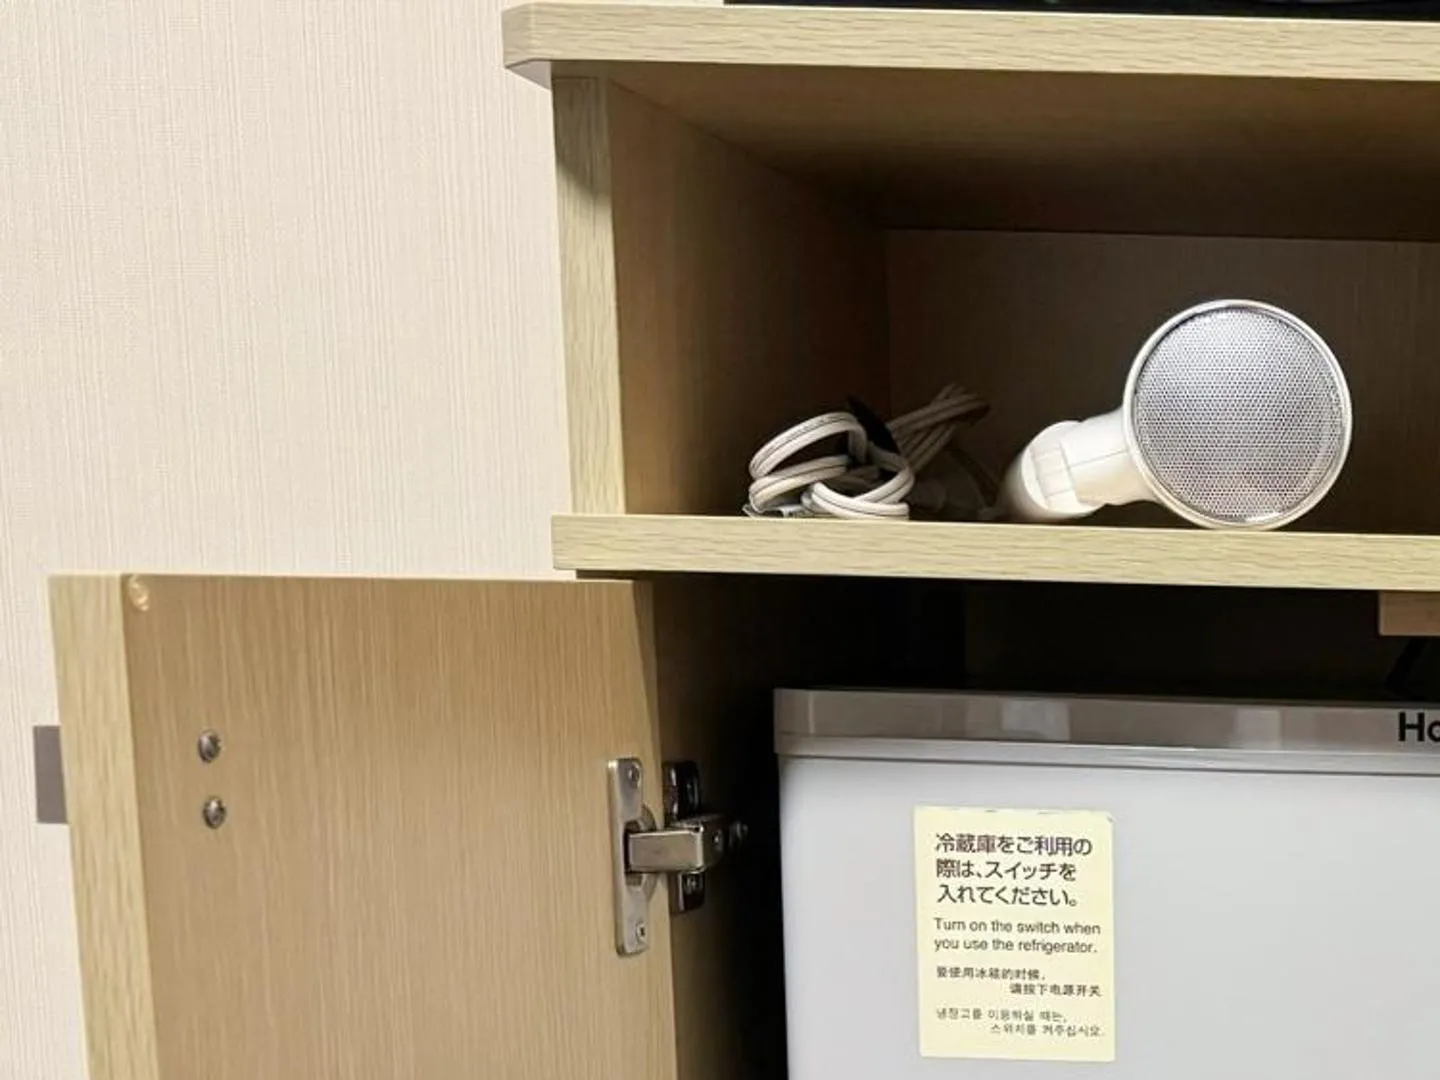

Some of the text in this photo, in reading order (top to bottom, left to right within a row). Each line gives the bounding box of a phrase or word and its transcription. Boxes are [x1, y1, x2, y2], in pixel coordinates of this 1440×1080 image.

[935, 832, 1093, 856] 冷蔵庫をご利用の
[936, 858, 1077, 881] 際は、スイッチを
[937, 884, 1077, 907] 入れてください。
[934, 917, 1102, 935] Turn on the switch when
[934, 938, 1099, 955] you use the refrigerator.
